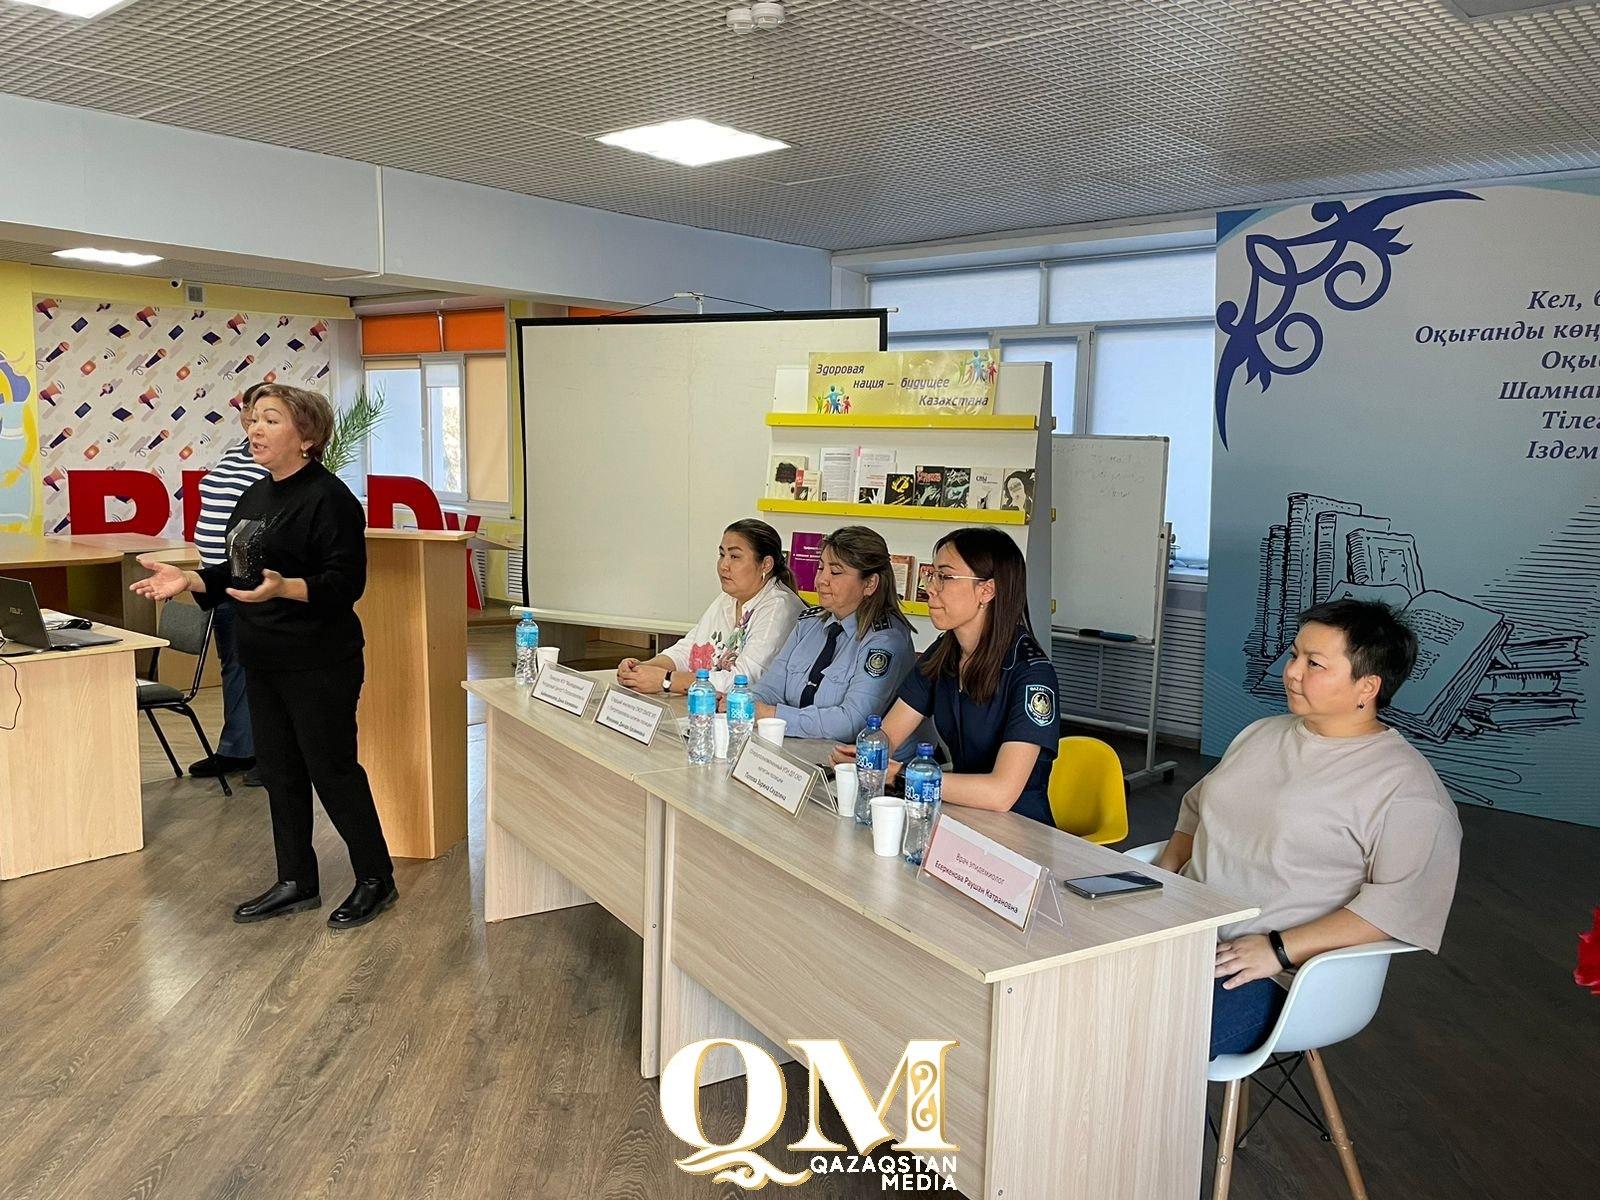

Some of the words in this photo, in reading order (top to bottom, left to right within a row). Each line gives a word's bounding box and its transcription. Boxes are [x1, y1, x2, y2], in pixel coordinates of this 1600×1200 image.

[1527, 290, 1583, 311] Кел,
[1415, 320, 1544, 346] Оқығанды
[816, 364, 865, 376] Здоровая
[1541, 350, 1600, 373] Оқы
[853, 379, 885, 389] нация
[900, 377, 950, 390] будущее
[919, 395, 989, 407] Казахстана
[955, 852, 969, 866] Врач
[969, 861, 1006, 886] эпидемиолог
[934, 860, 964, 883] Есеркенова
[964, 876, 986, 894] Раушан
[985, 888, 1019, 914] Катрановна
